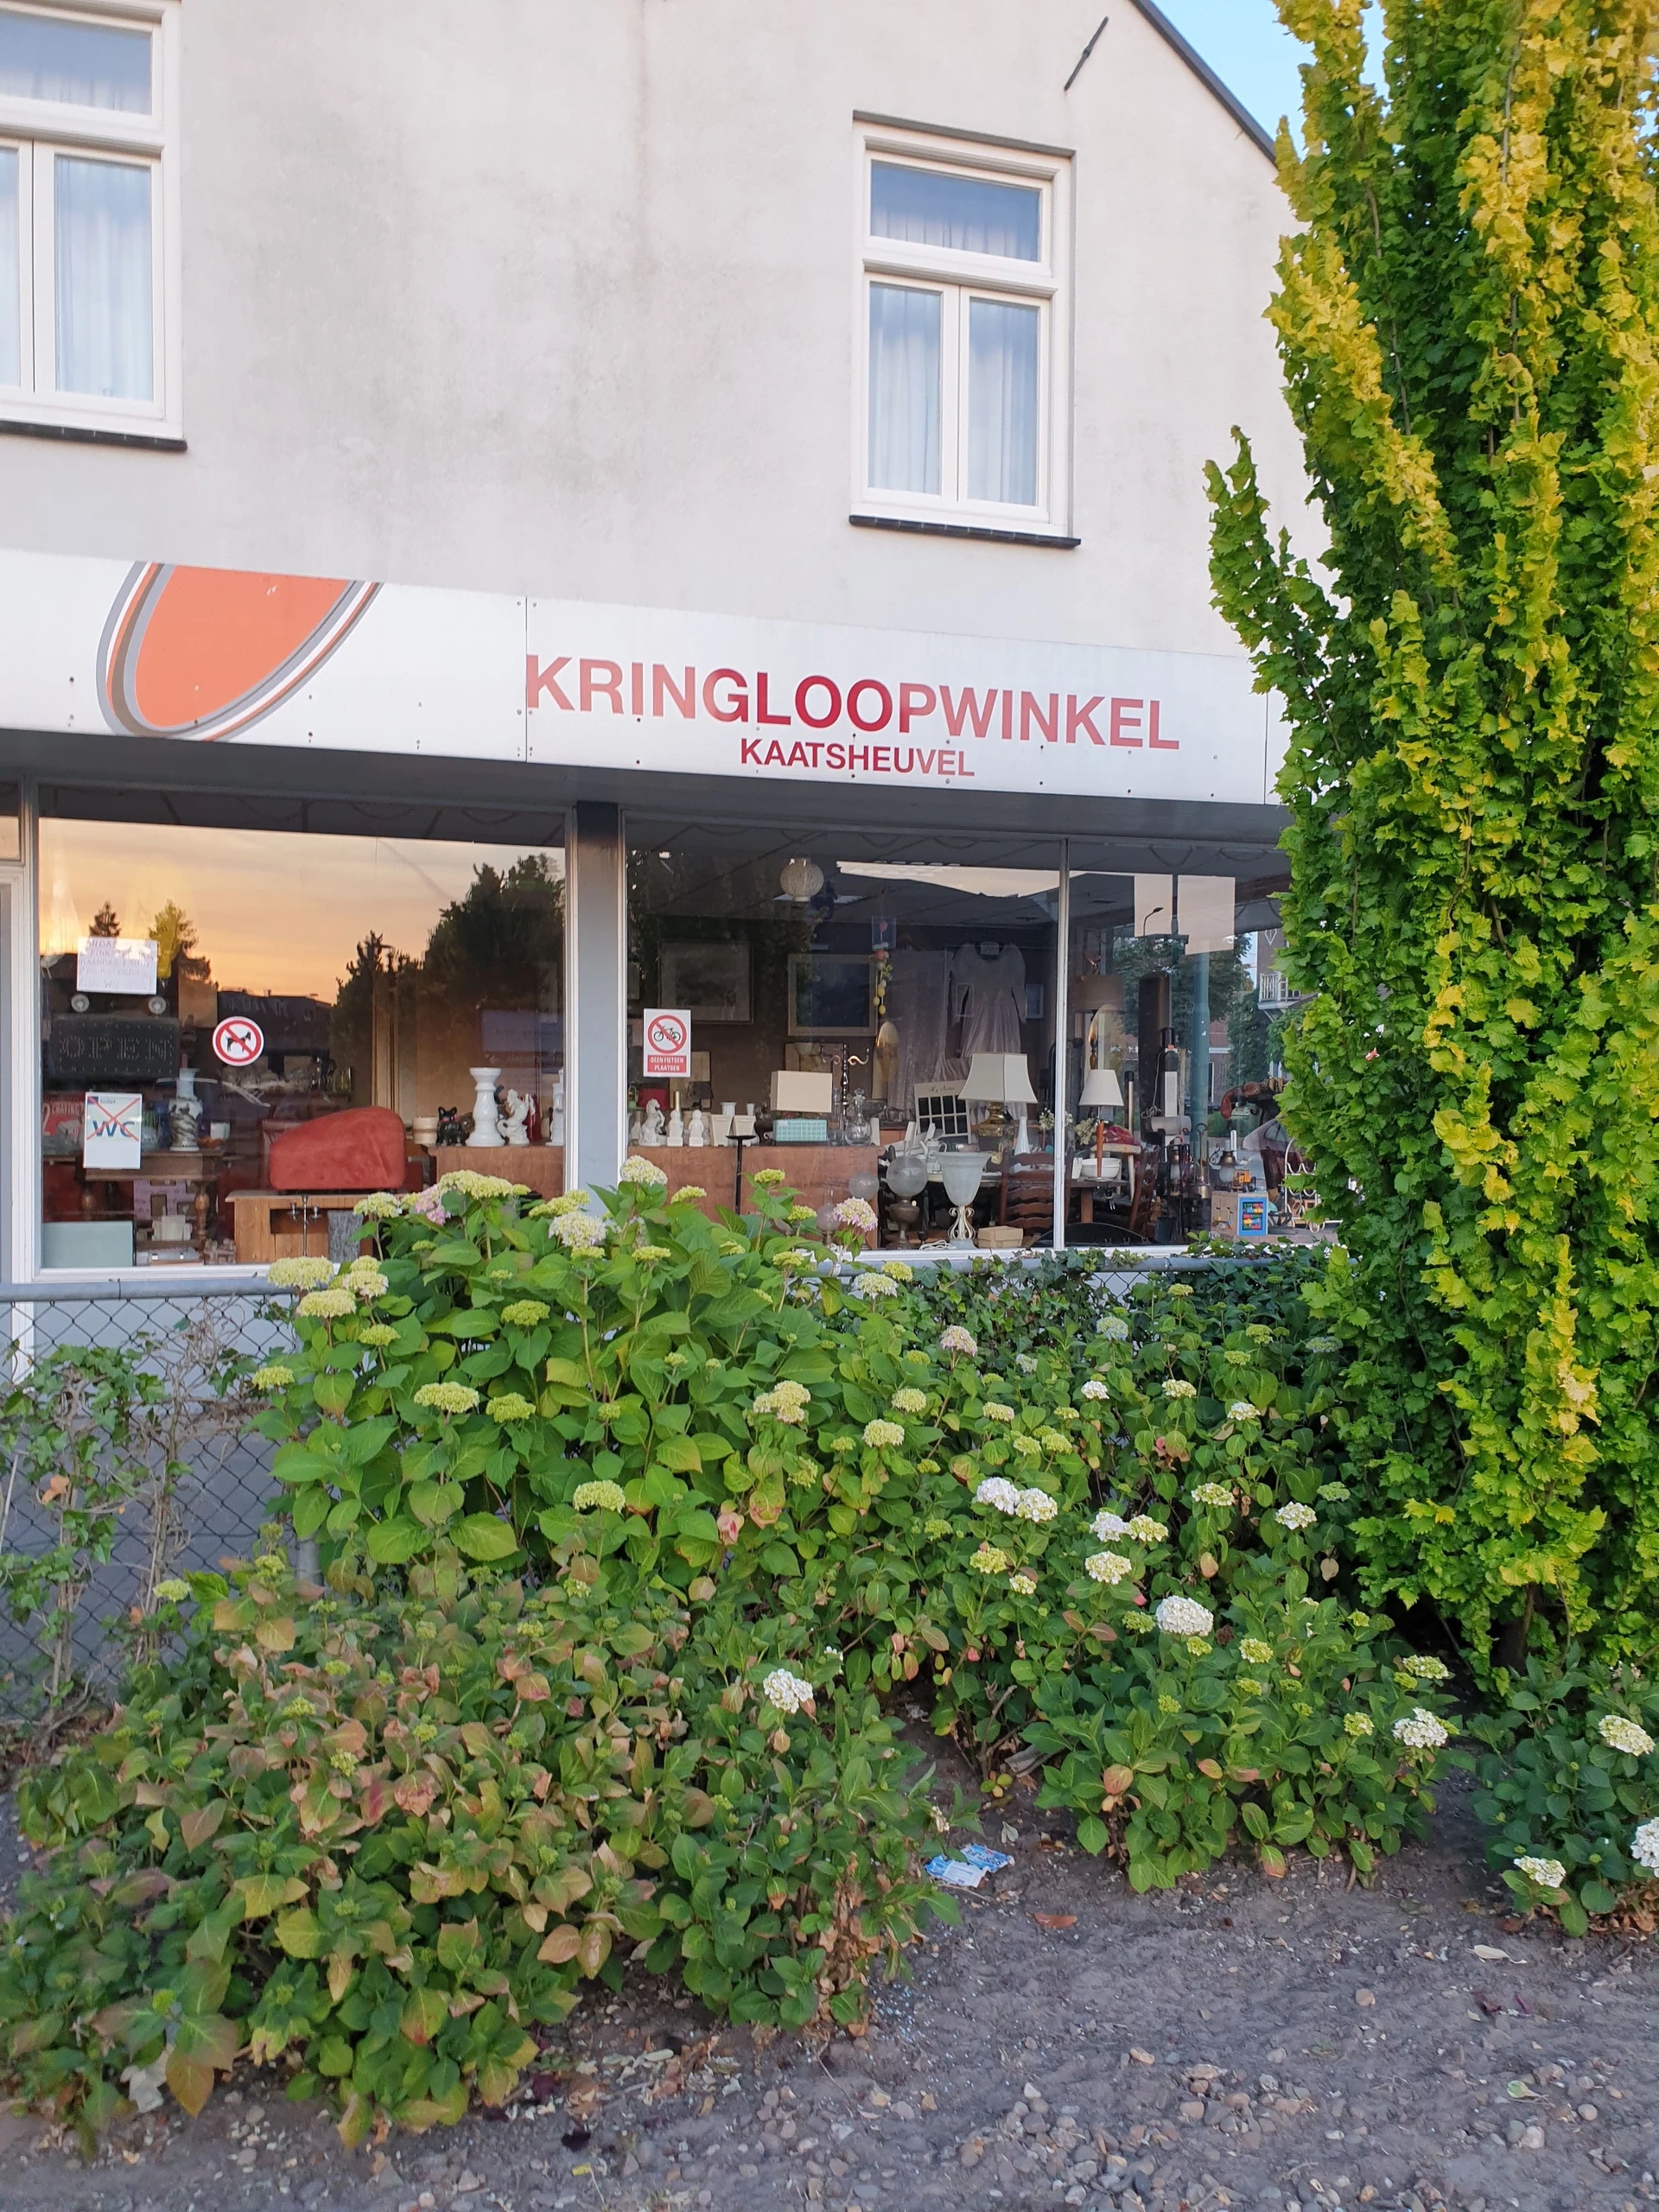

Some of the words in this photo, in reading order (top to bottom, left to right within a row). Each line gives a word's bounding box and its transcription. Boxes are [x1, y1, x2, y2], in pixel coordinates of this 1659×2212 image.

[526, 653, 1180, 751] KRINGLOOPWINKEL
[740, 737, 976, 778] KAATSHEUVEL
[59, 1035, 168, 1062] OPEN
[92, 1120, 135, 1137] WC
